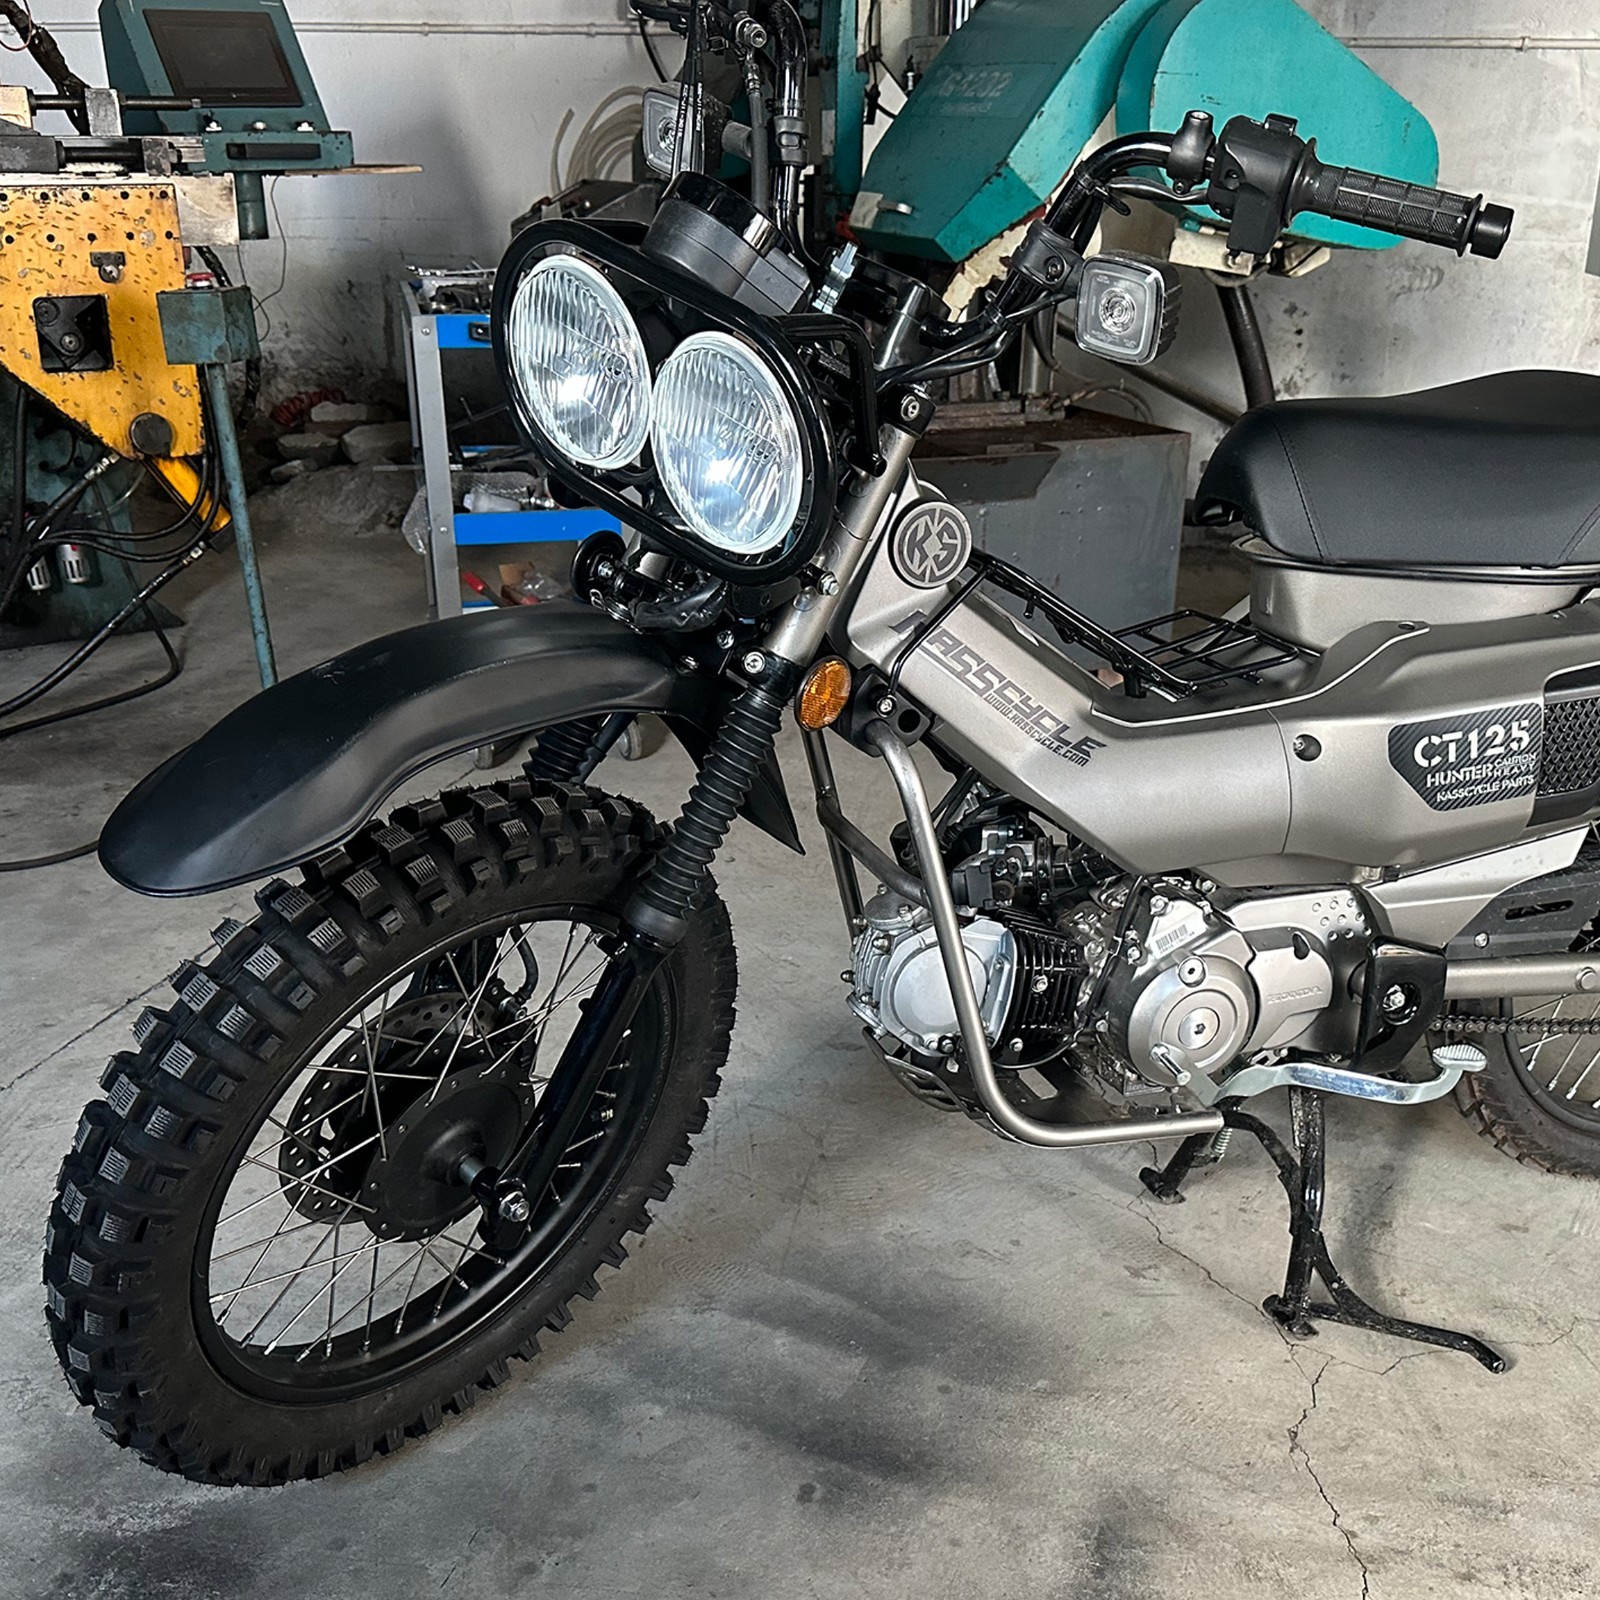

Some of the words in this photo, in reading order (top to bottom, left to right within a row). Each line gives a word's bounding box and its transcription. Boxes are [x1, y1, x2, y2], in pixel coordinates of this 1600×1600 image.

[1413, 719, 1530, 768] CT125
[1426, 763, 1494, 788] HUNTER
[1437, 780, 1500, 802] KASSCYCLE
[1501, 774, 1535, 790] PARTS
[1267, 985, 1323, 1005] HONDA
